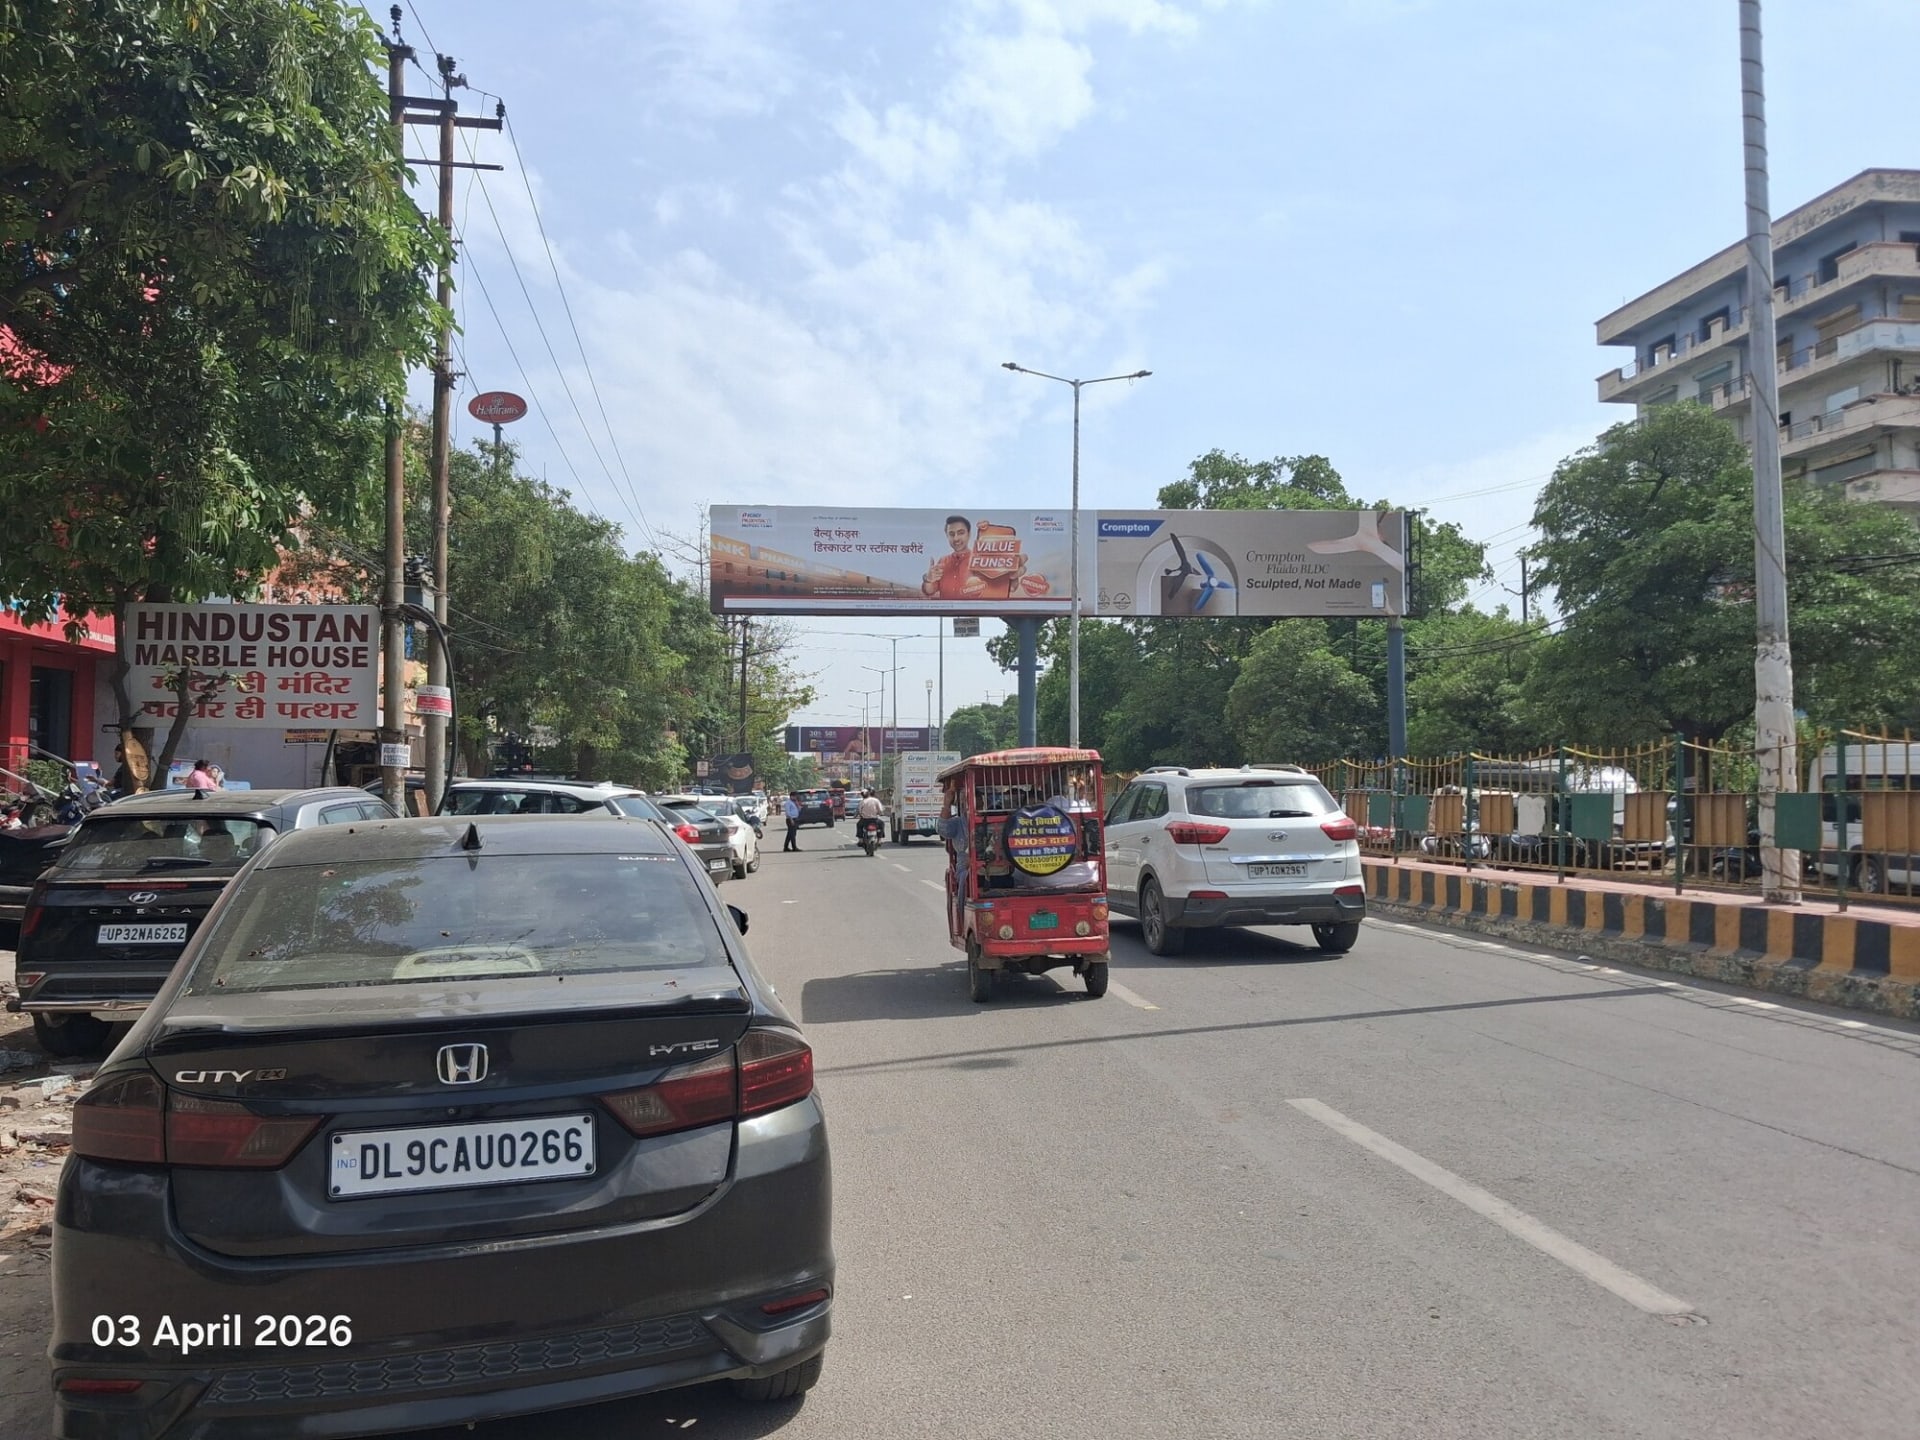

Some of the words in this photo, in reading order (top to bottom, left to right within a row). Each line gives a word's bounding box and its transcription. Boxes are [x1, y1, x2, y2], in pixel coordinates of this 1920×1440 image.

[814, 527, 834, 541] वैल्यू
[1101, 523, 1150, 534] Crompton
[814, 542, 853, 553] डिस्काउंट
[855, 545, 867, 553] पर
[900, 543, 925, 554] खरीदें
[976, 541, 1016, 552] VALUE
[972, 557, 1014, 567] FUNDS
[1246, 551, 1305, 564] Crompton
[1266, 564, 1298, 574] Fluido
[1300, 564, 1330, 574] BLDC
[1246, 578, 1302, 591] Sculpted,
[1304, 578, 1325, 589] Not
[1328, 578, 1362, 589] Made
[137, 612, 369, 643] HINDUSTAN
[135, 644, 257, 667] MARBLE
[268, 646, 369, 668] HOUSE
[235, 671, 267, 694] ही
[277, 671, 352, 695] मंदिर
[235, 696, 267, 719] ही
[275, 701, 360, 720] पत्थर
[1014, 838, 1046, 846] NIOS
[89, 907, 192, 915] CRETA
[107, 927, 185, 941] UP32NA6262
[176, 1069, 254, 1083] CITY
[258, 1069, 286, 1080] ZX
[360, 1127, 583, 1180] DL9CAU0266
[336, 1158, 357, 1169] IND
